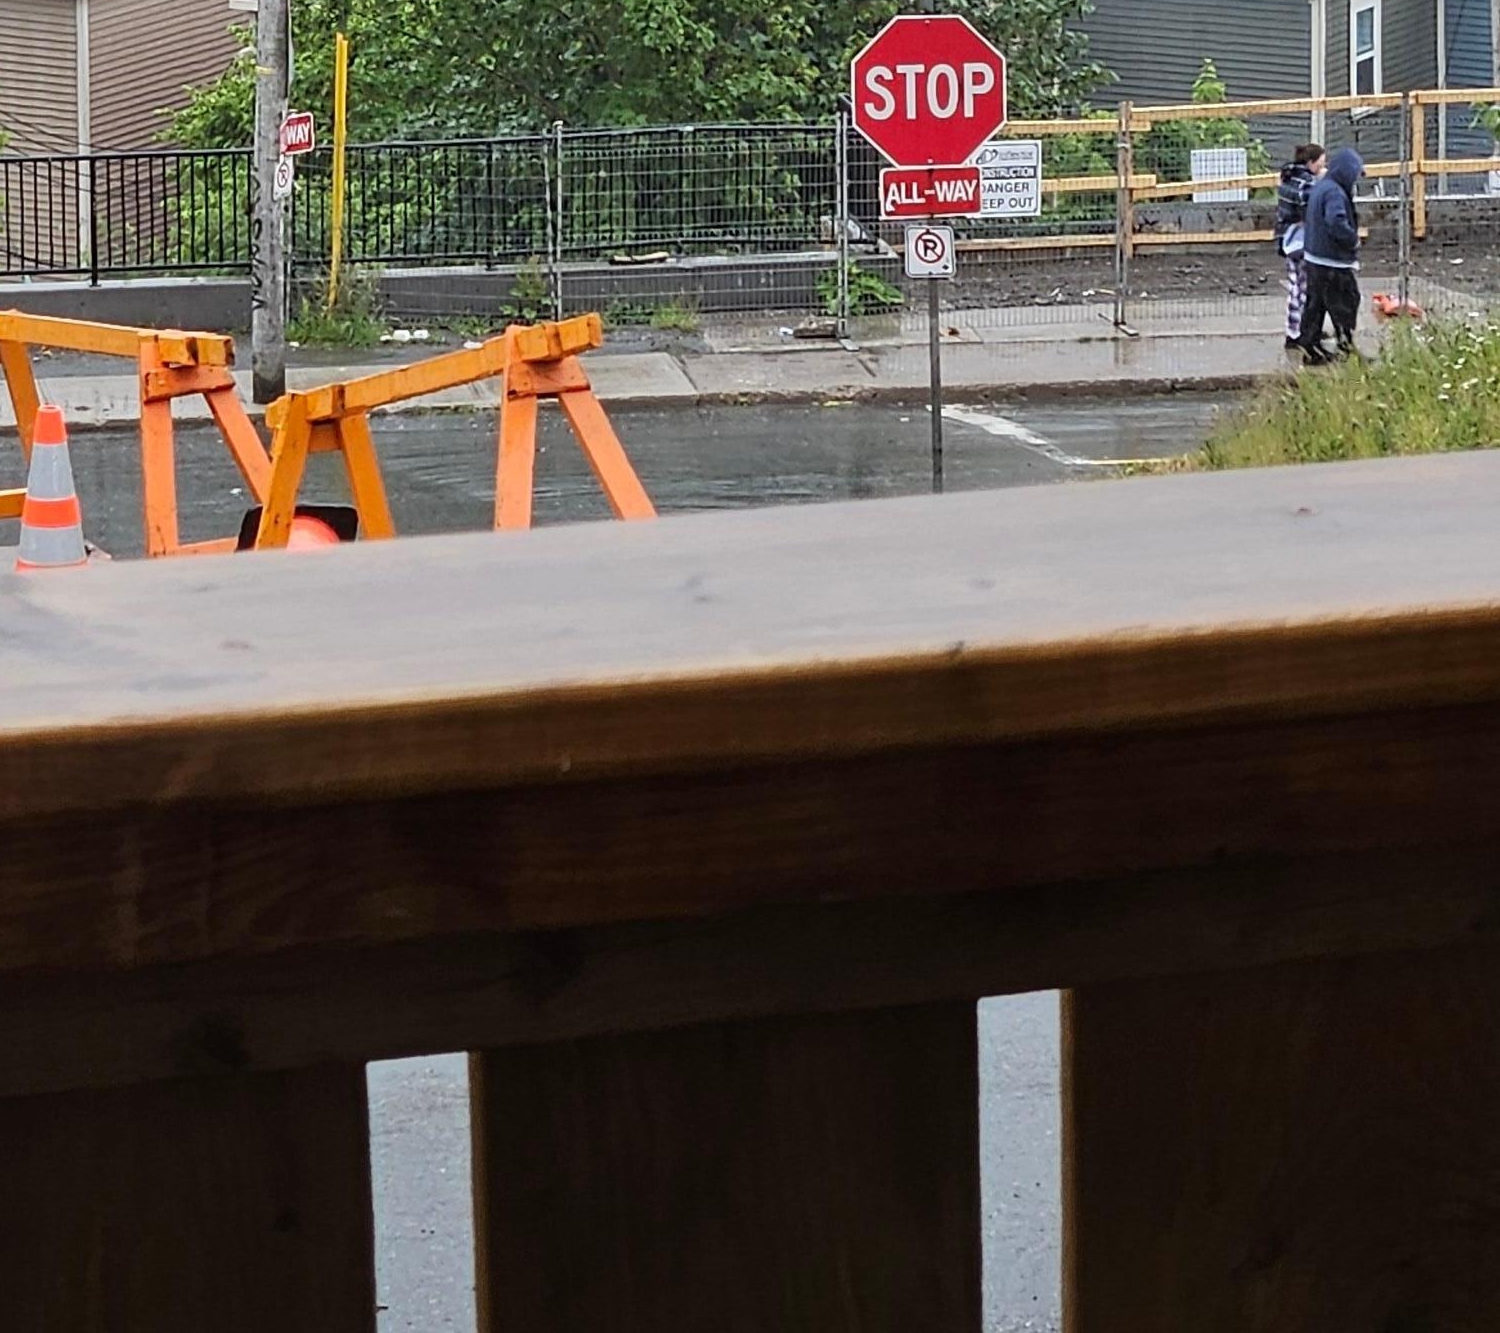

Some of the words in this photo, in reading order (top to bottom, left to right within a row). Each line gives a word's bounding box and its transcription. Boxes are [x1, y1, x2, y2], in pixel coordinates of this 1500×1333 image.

[864, 62, 994, 121] STOP
[886, 180, 978, 205] ALL-WAY
[982, 198, 1004, 210] EEP
[1008, 197, 1034, 208] OUT
